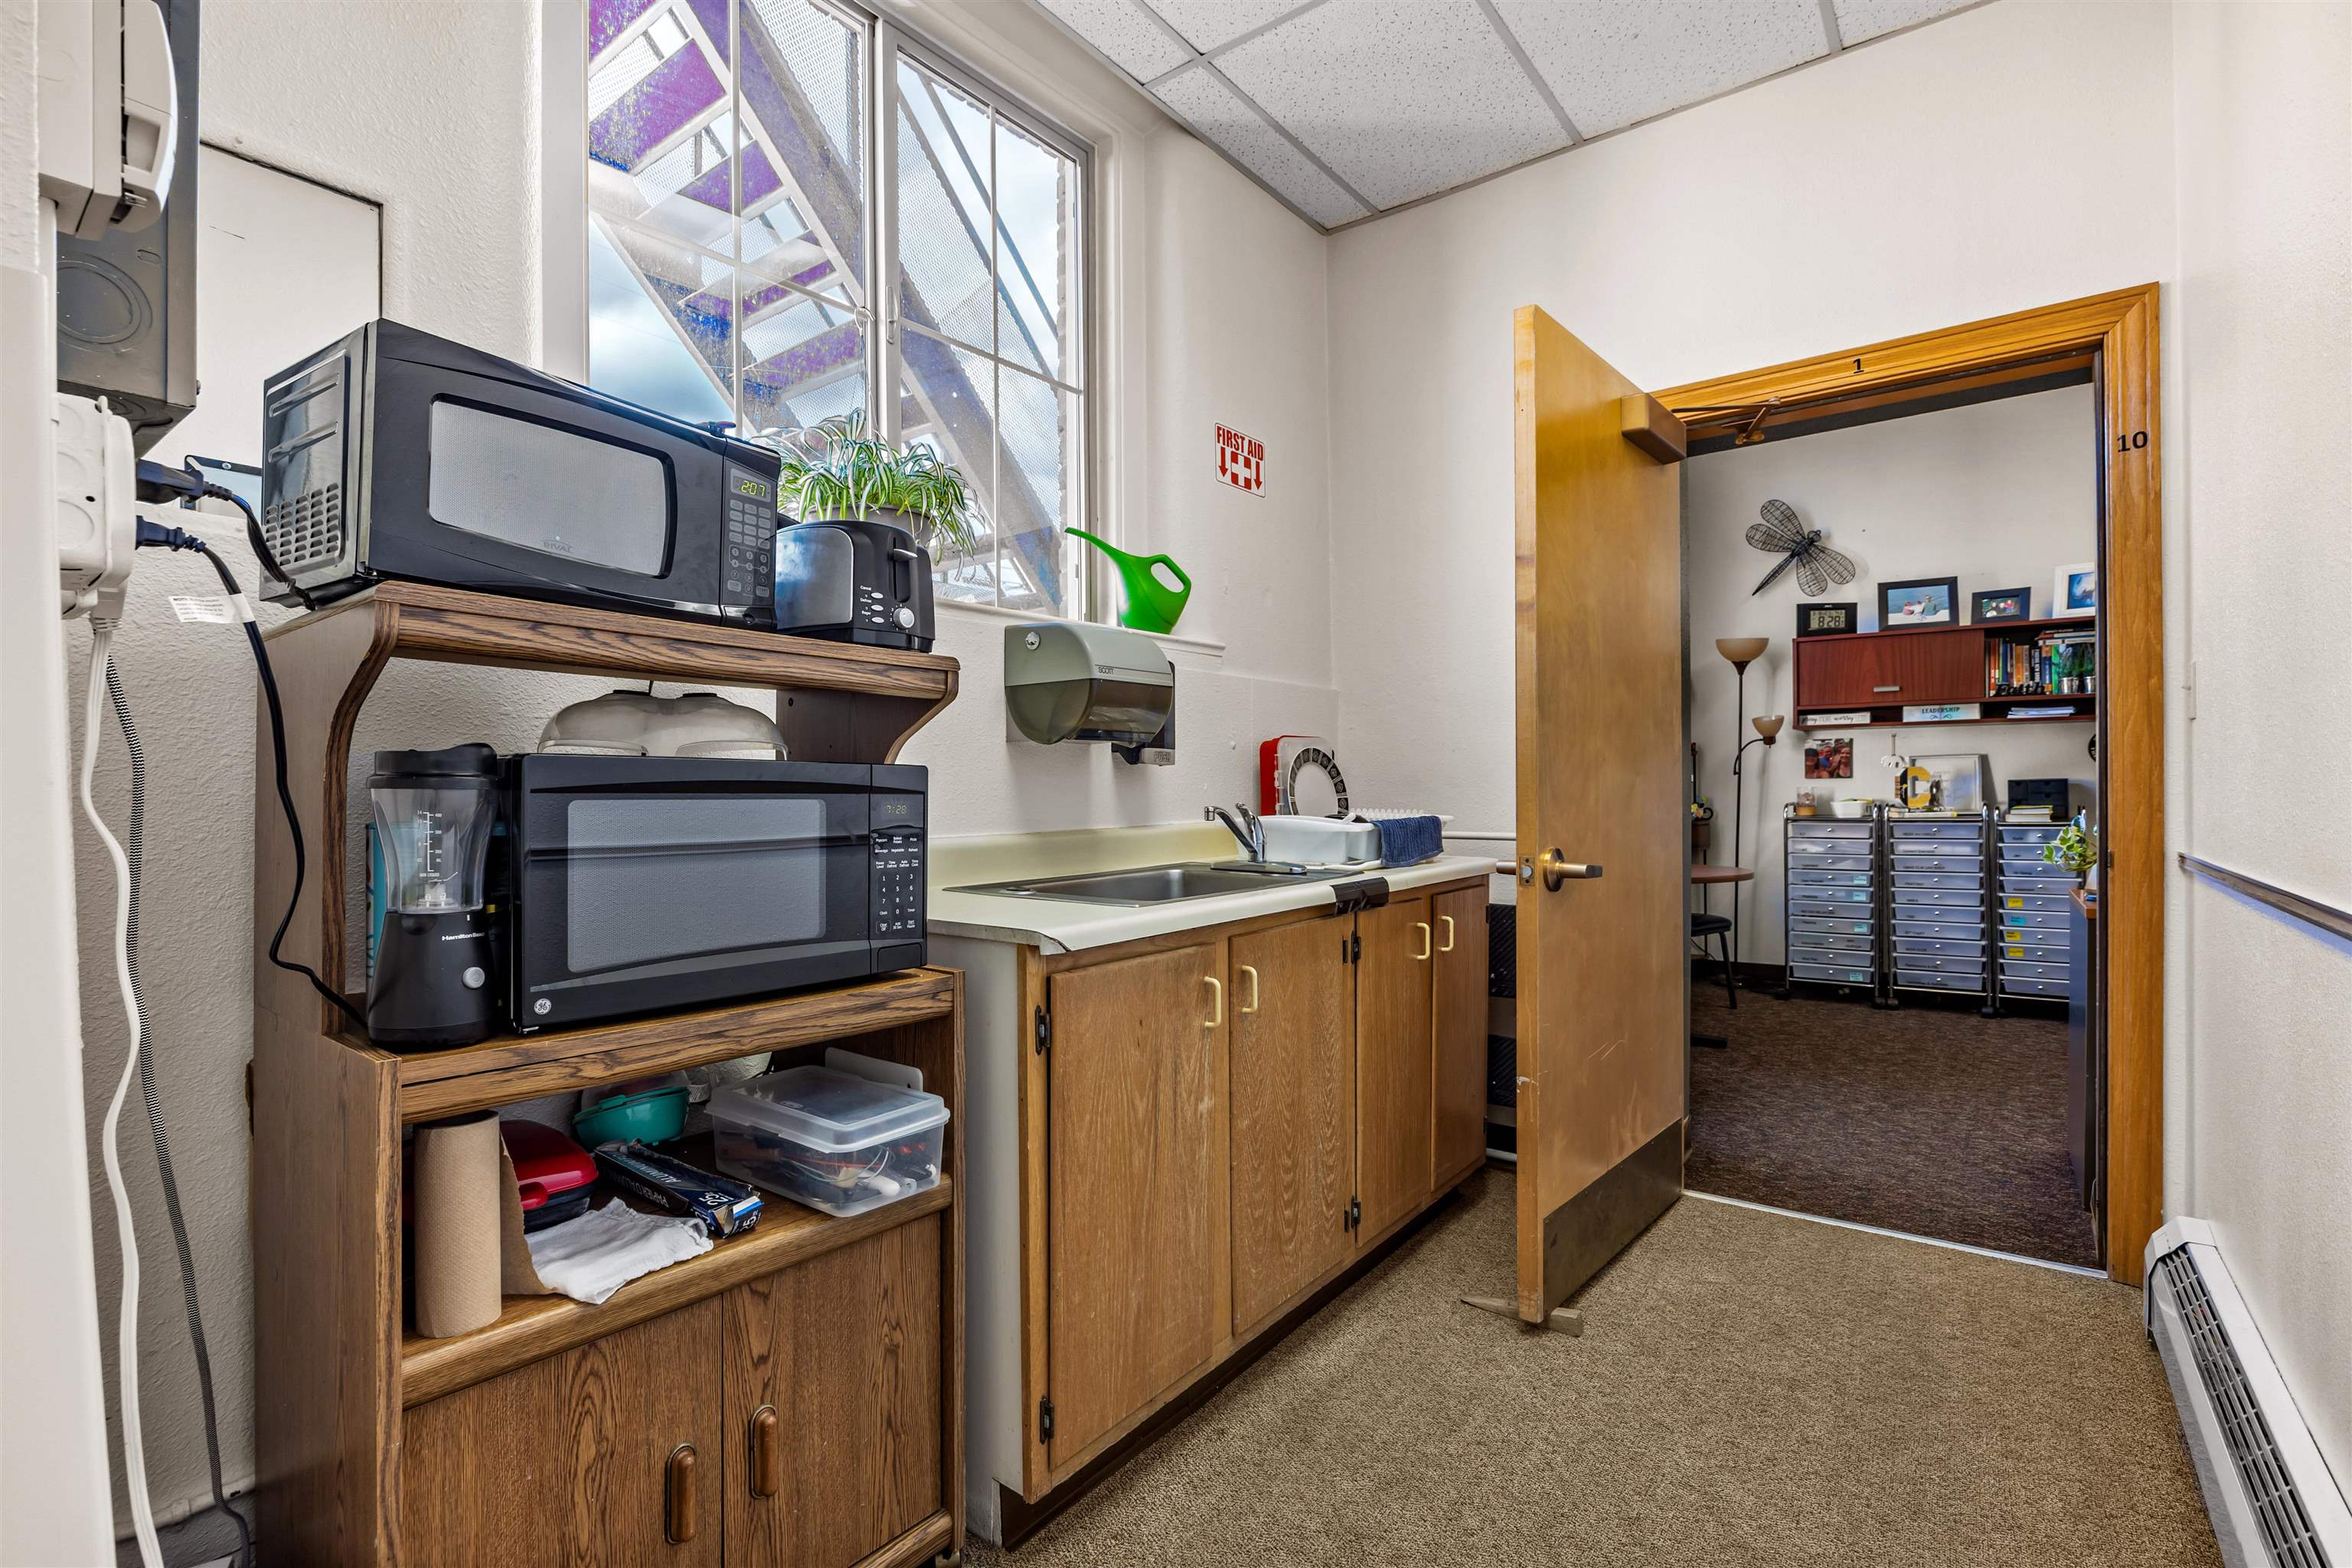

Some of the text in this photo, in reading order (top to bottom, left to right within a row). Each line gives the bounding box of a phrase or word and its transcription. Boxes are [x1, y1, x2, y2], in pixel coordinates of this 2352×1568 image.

[1854, 358, 1864, 374] 1
[1217, 426, 1264, 461] FIRST AID
[2117, 431, 2148, 452] 10
[741, 480, 766, 497] 2:07
[1098, 666, 1113, 675] SCOTT
[1154, 751, 1171, 763] PUSH
[698, 1194, 730, 1205] 25
